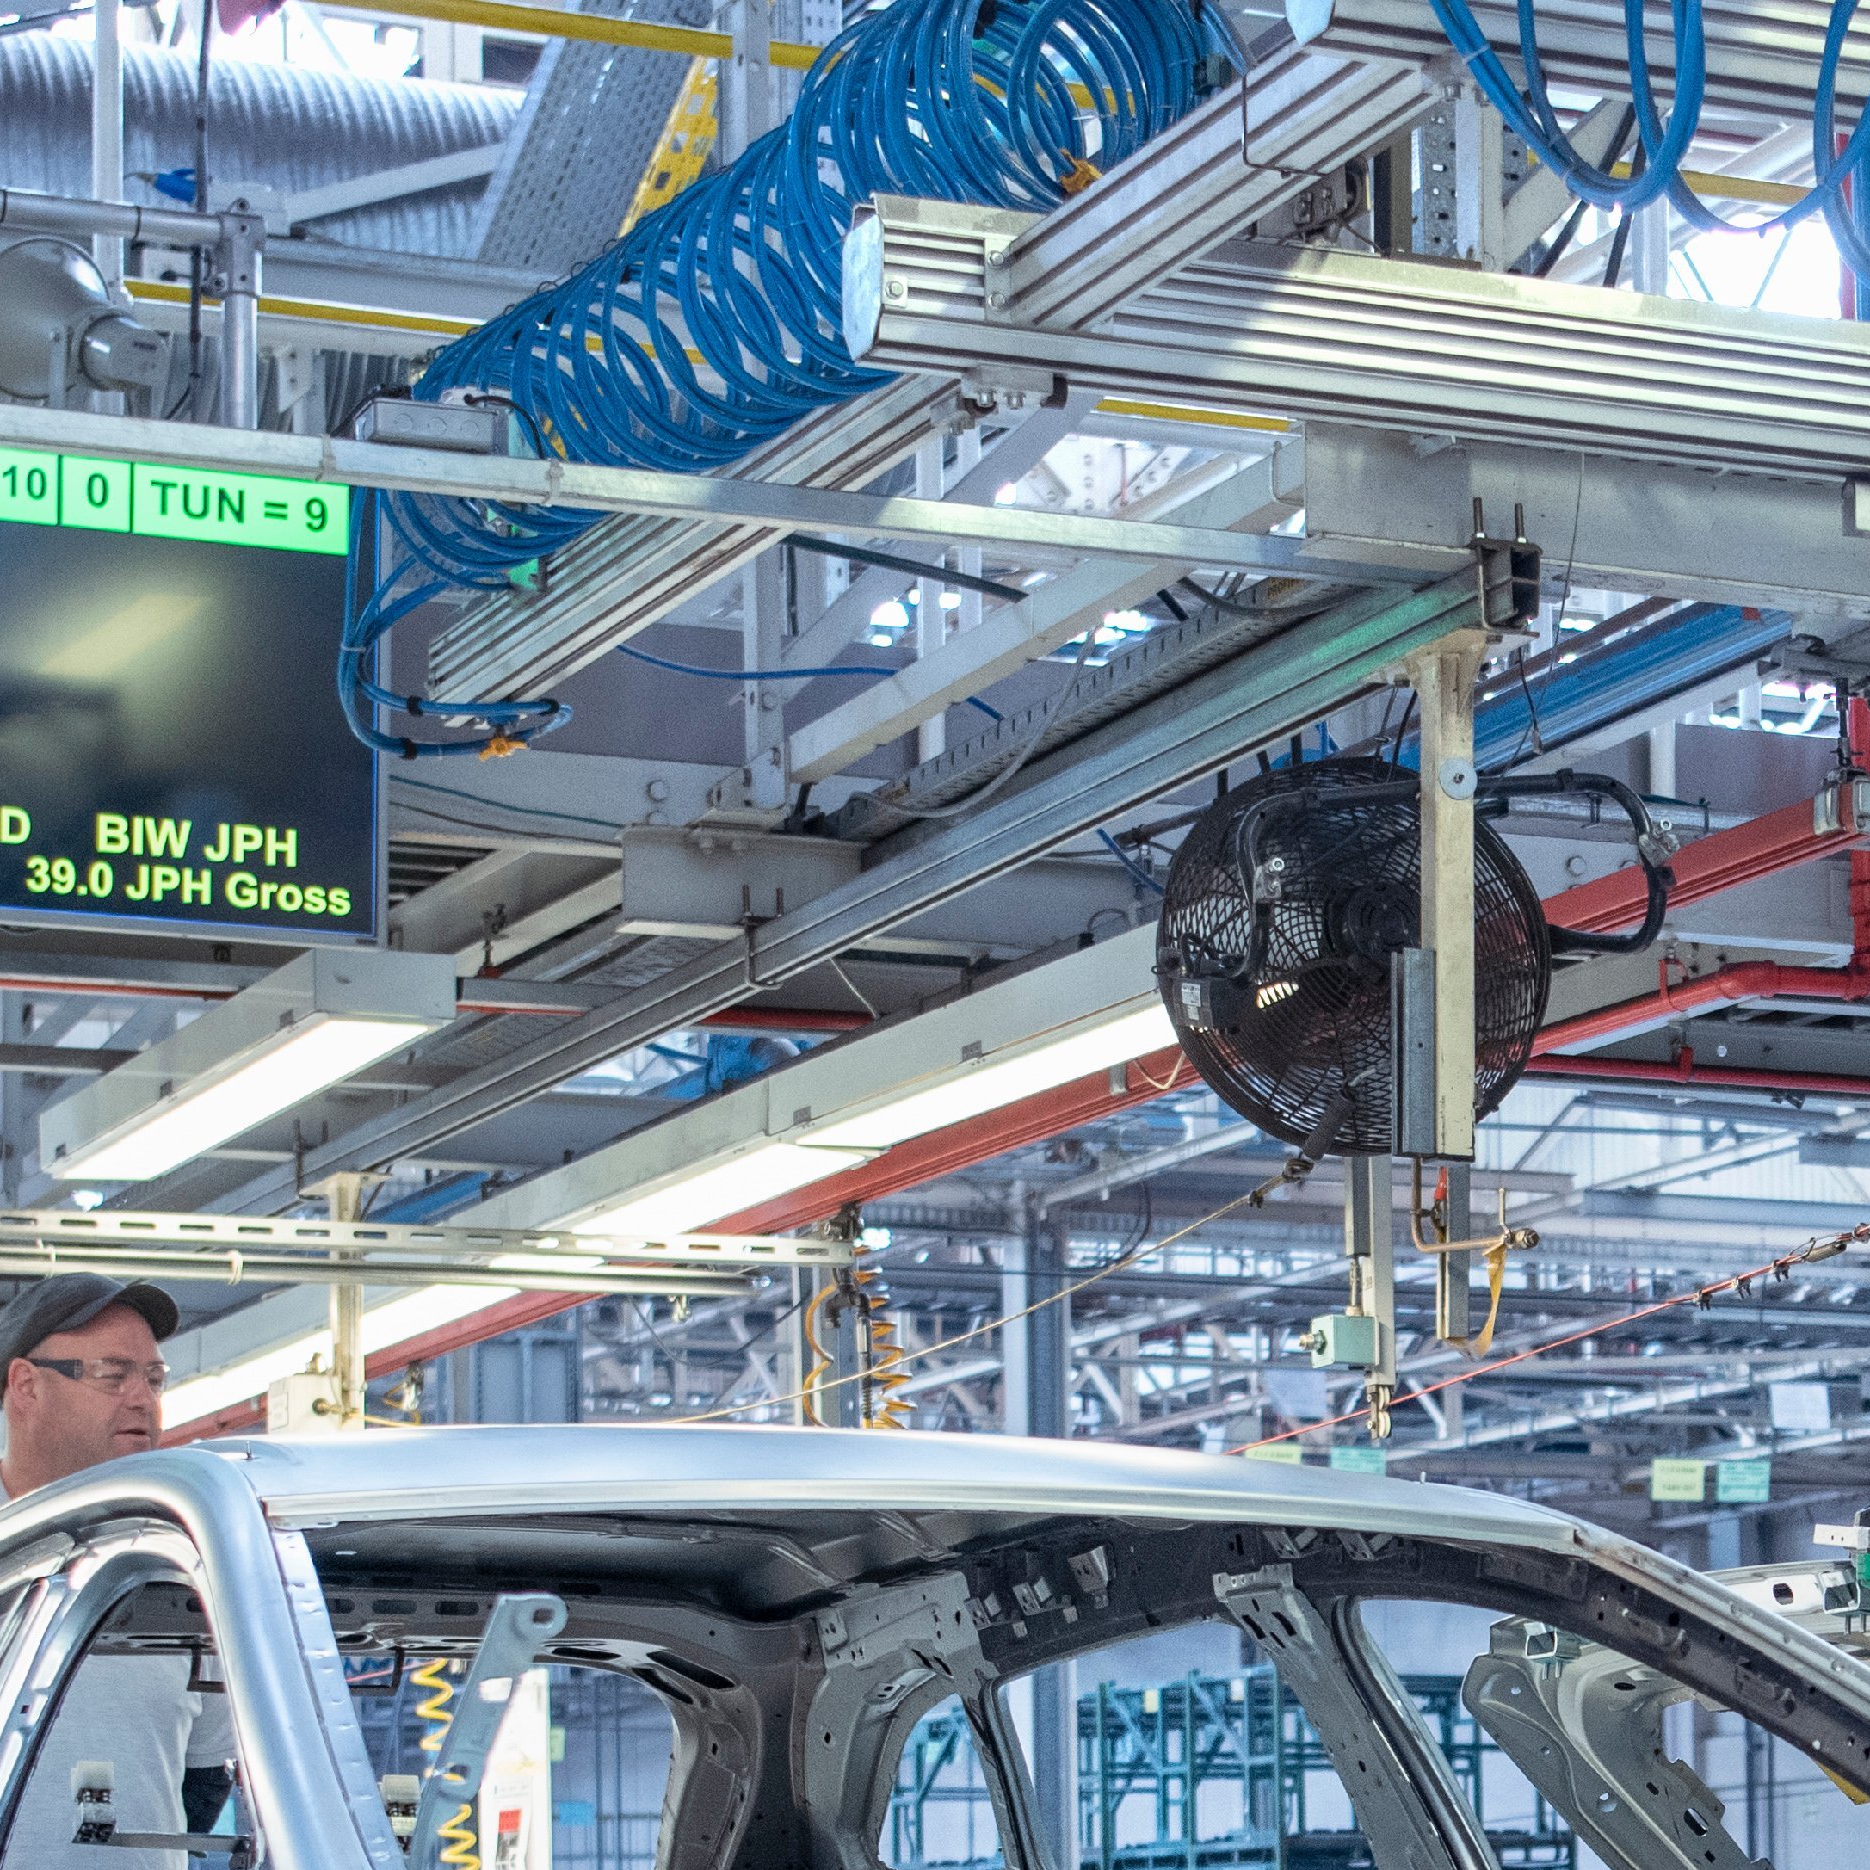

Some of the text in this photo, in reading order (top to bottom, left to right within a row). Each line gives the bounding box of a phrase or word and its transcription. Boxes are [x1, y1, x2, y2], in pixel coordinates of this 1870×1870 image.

[85, 472, 110, 508] 0
[151, 481, 246, 525] TUN
[305, 496, 329, 532] 9
[95, 812, 193, 859] BIW
[203, 822, 298, 868] JPH
[25, 855, 114, 899] 39.0
[125, 863, 212, 905] JPH
[224, 871, 352, 917] Gross
